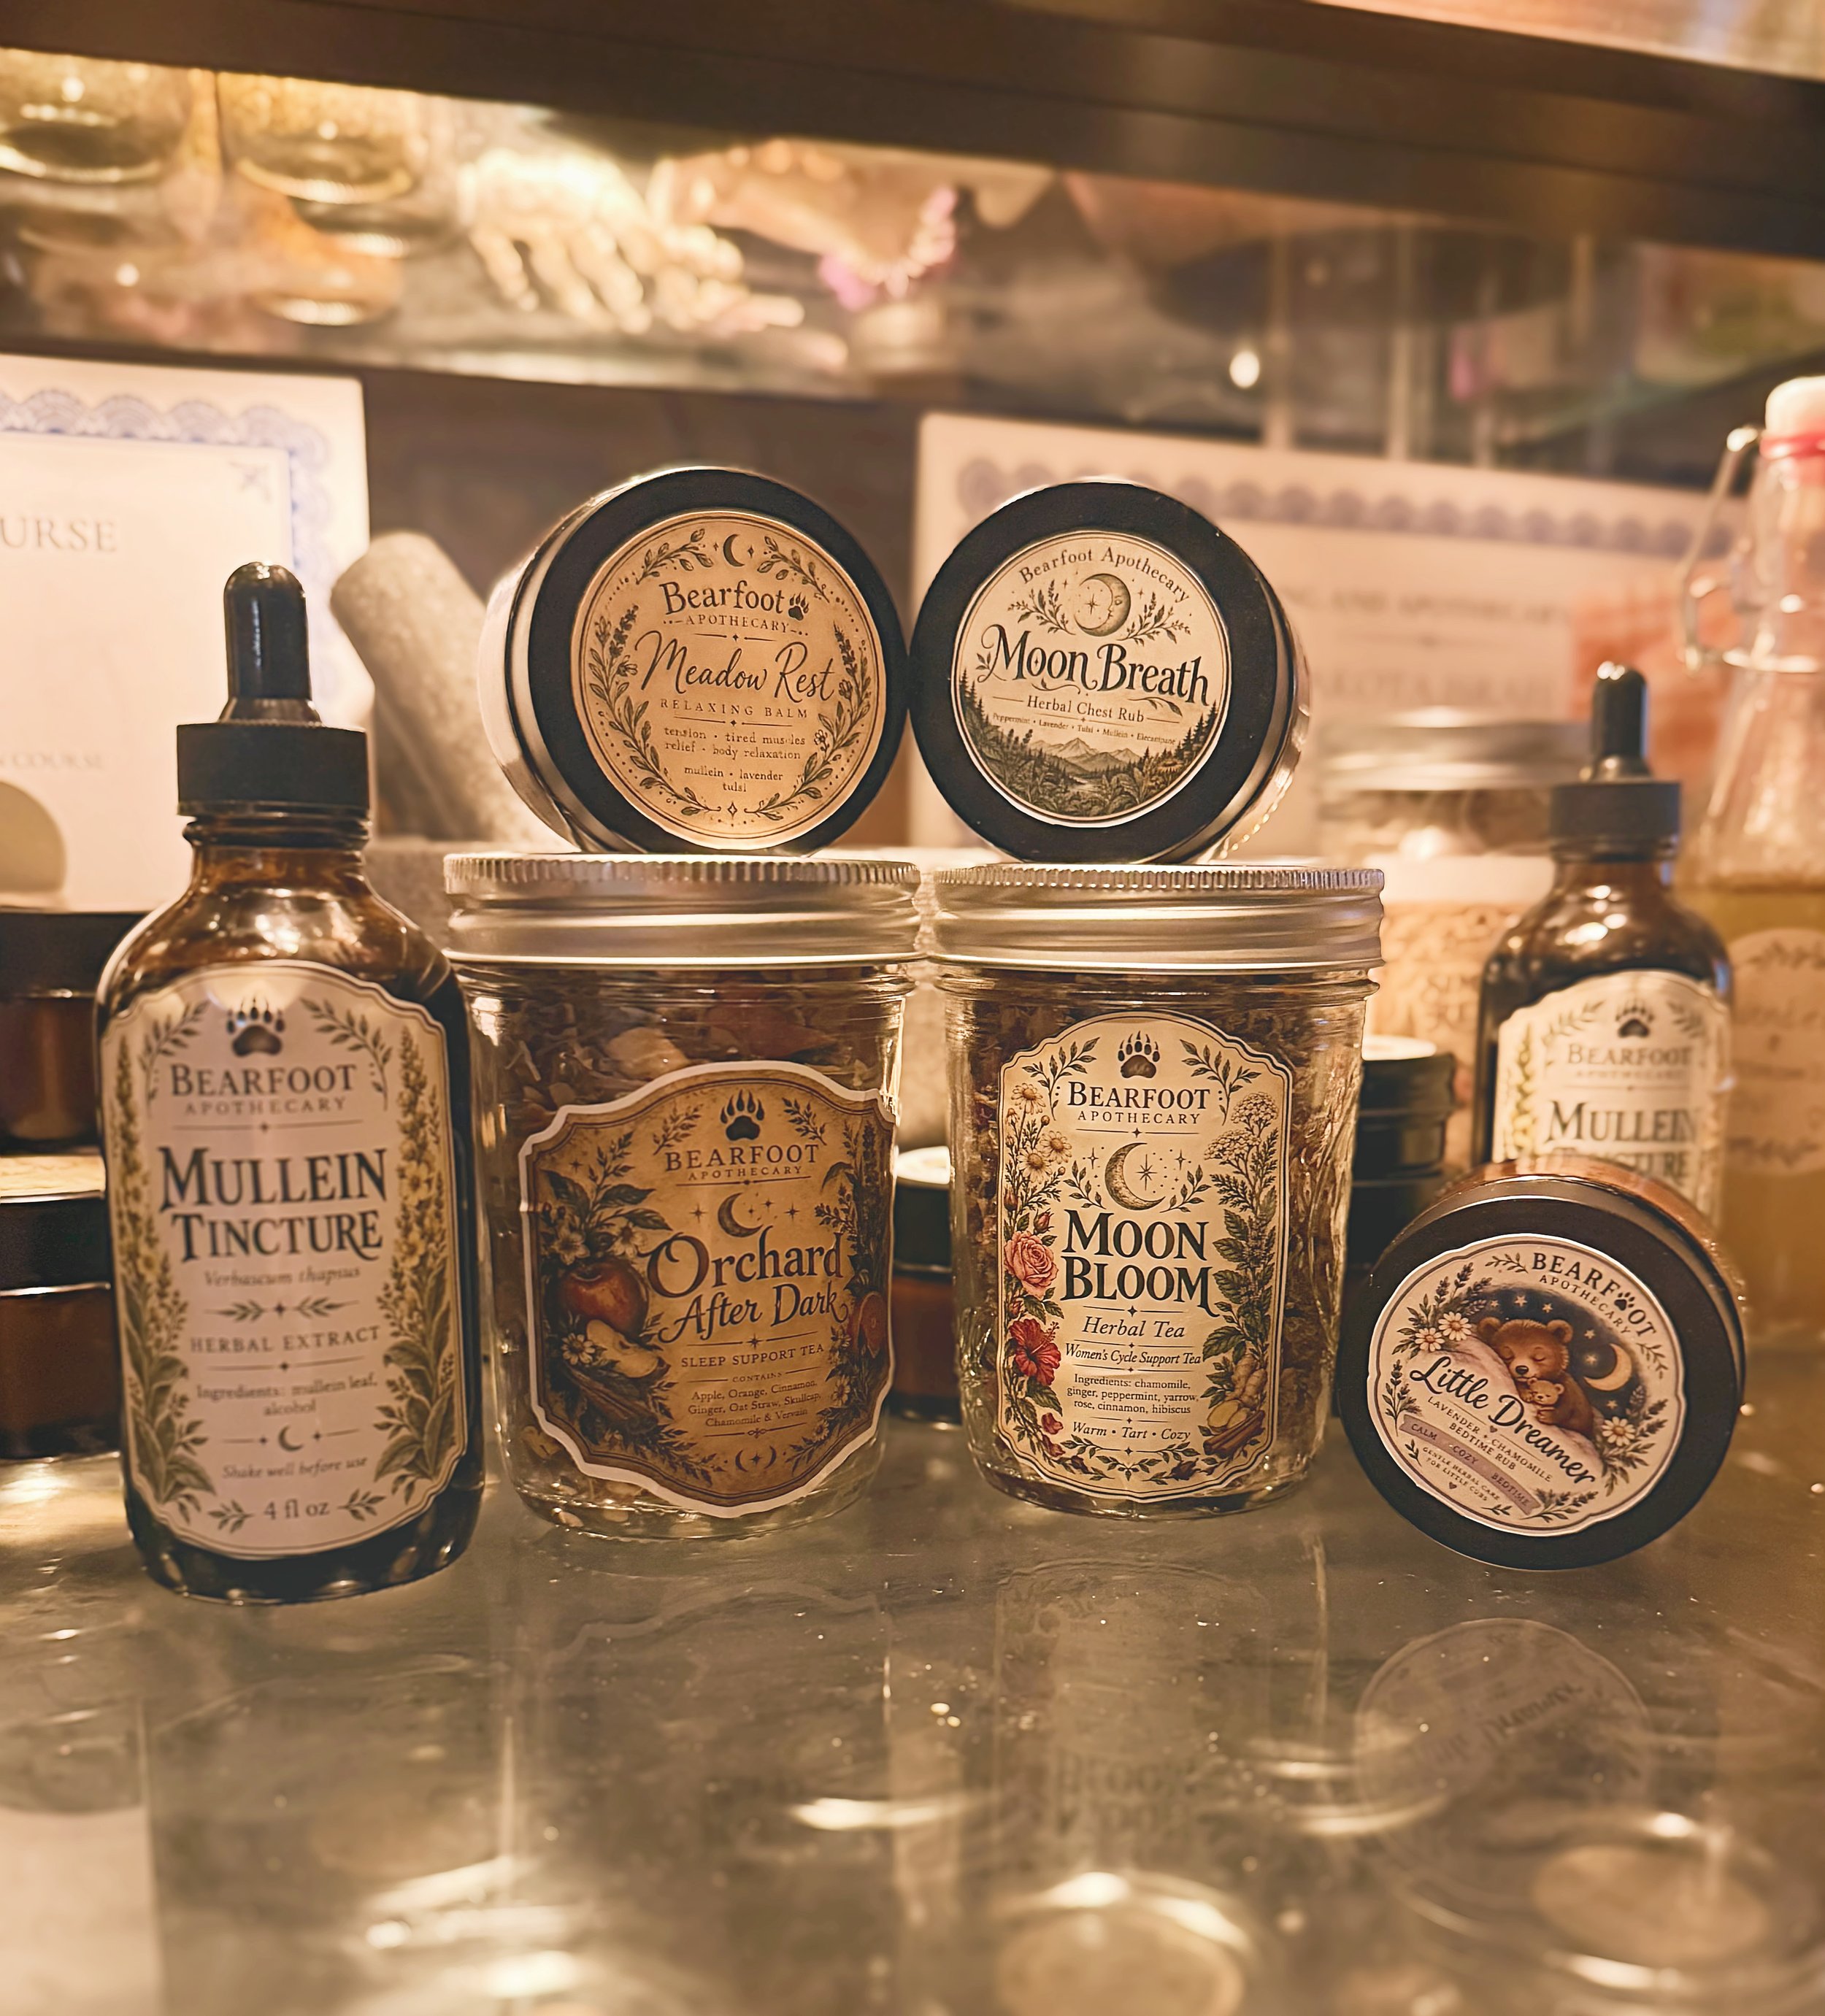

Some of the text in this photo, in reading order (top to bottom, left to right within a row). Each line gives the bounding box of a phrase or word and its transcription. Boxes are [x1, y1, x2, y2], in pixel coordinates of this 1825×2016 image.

[1019, 547, 1190, 604] Bearfoot Apothecary
[659, 580, 784, 615] Bearfoot
[686, 615, 789, 633] APOTHECARY
[634, 631, 835, 703] Meadow Rest
[977, 623, 1209, 706] Moon Breath
[661, 699, 808, 719] RELAXING BALM
[1026, 695, 1145, 723] Herbal Chest Rub
[664, 727, 805, 745] tension tired musles
[1039, 719, 1069, 730] Lavender
[1102, 728, 1128, 738] Mullein
[665, 739, 695, 753] relief
[744, 747, 801, 759] relaxation
[685, 766, 783, 780] mullein lavender
[723, 782, 747, 792] tulsi
[169, 1063, 358, 1097] BEARFOOT
[184, 1096, 347, 1116] APOTHECARY
[1067, 1080, 1210, 1110] BEARFOOT
[1078, 1110, 1201, 1125] APOTHECARY
[1543, 1100, 1701, 1144] MULLEIN
[665, 1144, 819, 1171] BEARFOOT
[156, 1146, 388, 1214] MULLEIN
[688, 1166, 802, 1181] APOTHECARY
[170, 1209, 384, 1263] TINCTURE
[1061, 1209, 1210, 1261] MOON
[636, 1225, 844, 1299] Orchard
[1060, 1255, 1220, 1317] BLOOM
[658, 1281, 849, 1343] After Dark
[1539, 1274, 1631, 1334] APOTHECARY
[191, 1326, 380, 1353] HERBAL EXTRACT
[1082, 1316, 1186, 1339] Herbal Tea
[681, 1344, 824, 1368] SLEEP SUPPORT TEA
[1066, 1342, 1202, 1367] Women's Cycle Support Tea
[732, 1372, 783, 1383] CONTAINS
[1075, 1373, 1191, 1390] Ingredients: chamomile,
[264, 1398, 316, 1416] alcohol
[691, 1390, 725, 1402] Apple,
[730, 1403, 748, 1412] Oat
[1067, 1387, 1199, 1404] ginger, peppermint, yarrow,
[1074, 1401, 1191, 1414] rose, cinnamon, hibiscus
[705, 1415, 761, 1427] Chamomile
[764, 1413, 772, 1422] &
[1072, 1422, 1191, 1442] Warm Tart Cozy
[1410, 1355, 1596, 1486] Little Dreamer
[1428, 1396, 1553, 1482] LAVENDER CHAMOMILE
[1449, 1423, 1516, 1470] BEDTIME RUB
[266, 1462, 294, 1476] well
[299, 1458, 341, 1477] before
[1410, 1424, 1437, 1440] CALM
[1491, 1471, 1532, 1507] BEDTIME
[264, 1498, 330, 1520] 4 fl oz
